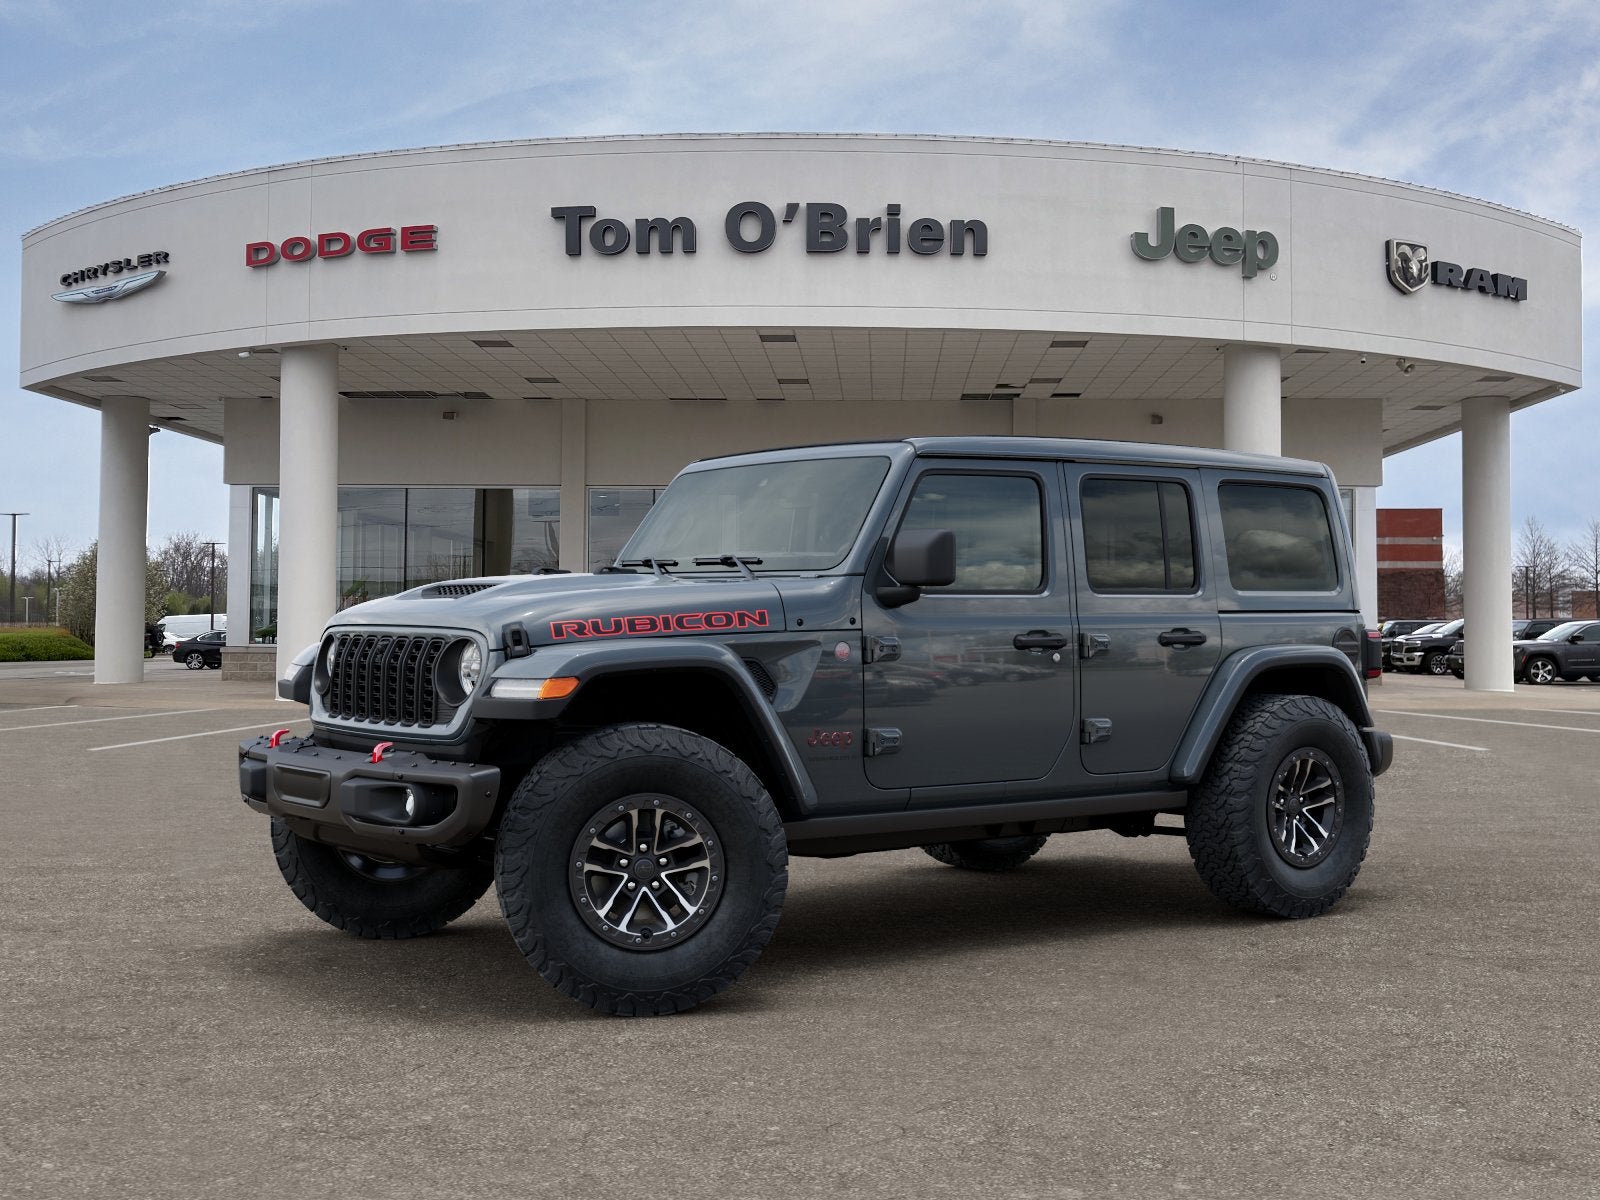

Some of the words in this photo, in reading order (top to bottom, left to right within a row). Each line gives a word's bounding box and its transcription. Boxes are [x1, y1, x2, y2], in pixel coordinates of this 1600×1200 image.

[245, 225, 438, 269] DODGE
[551, 205, 697, 256] Tom
[1130, 206, 1279, 279] Jeep
[60, 250, 170, 287] CHRYSLER
[1431, 260, 1528, 302] RAM
[550, 609, 769, 640] RUBICON
[807, 728, 853, 752] Jeep
